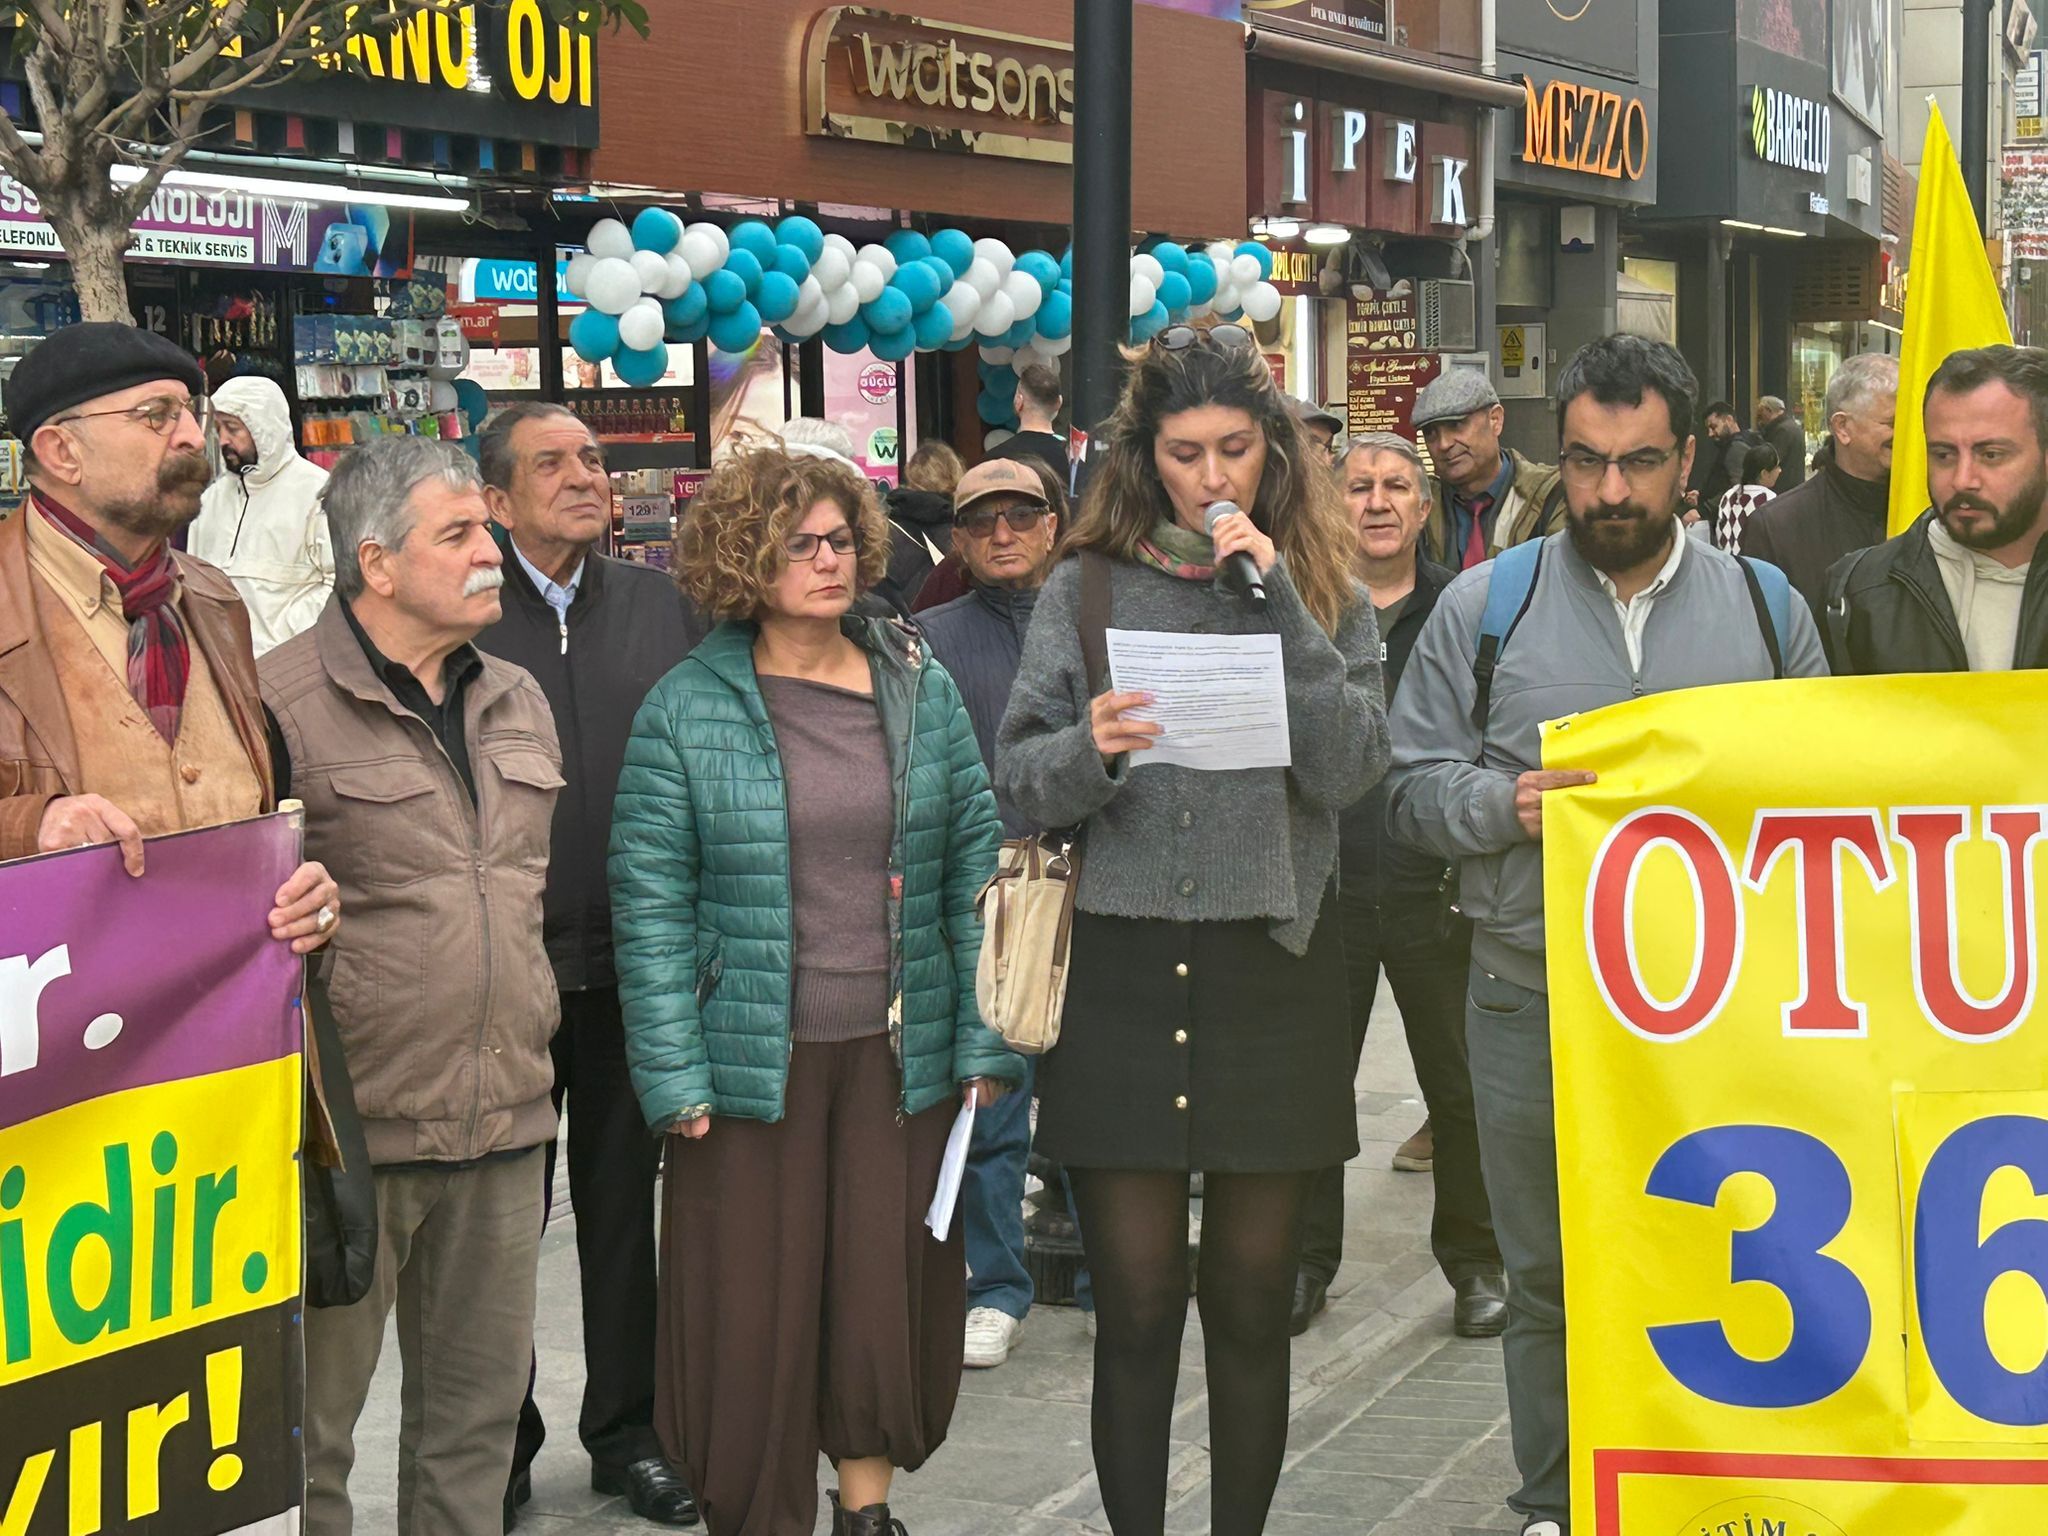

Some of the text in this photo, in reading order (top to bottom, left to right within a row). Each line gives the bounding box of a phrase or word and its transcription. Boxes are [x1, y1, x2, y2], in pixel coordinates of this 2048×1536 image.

[1522, 73, 1649, 181] MEZZO
[1766, 87, 1830, 175] BARGELLO
[0, 229, 55, 246] LEFONU
[157, 237, 202, 256] TEKNİK
[205, 241, 248, 259] SERVİS
[1645, 1114, 2048, 1426] 36
